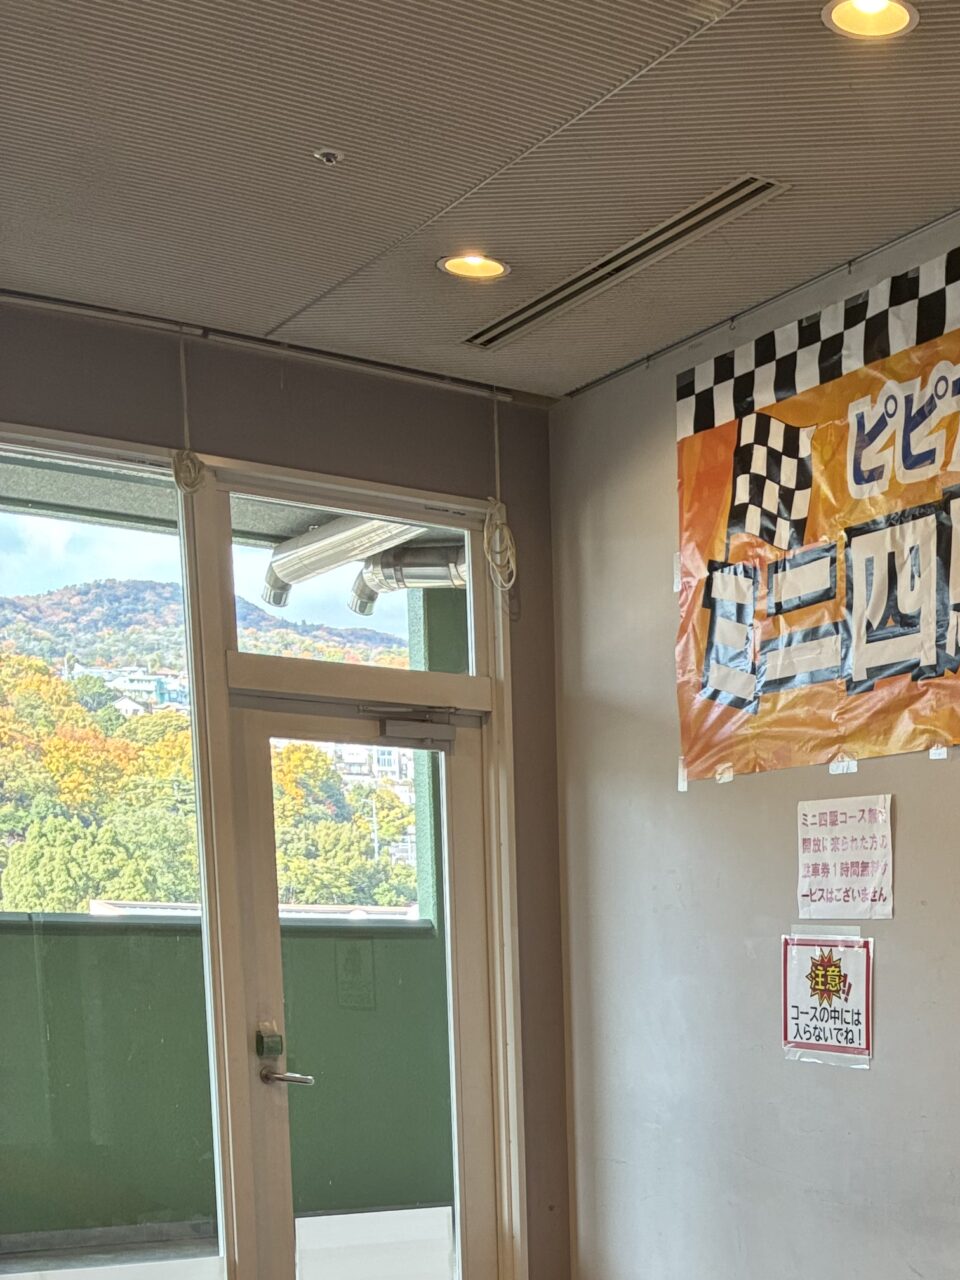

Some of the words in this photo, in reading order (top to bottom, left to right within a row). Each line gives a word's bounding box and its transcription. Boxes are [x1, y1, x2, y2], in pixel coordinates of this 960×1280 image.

[791, 1005, 862, 1026] コースの中には
